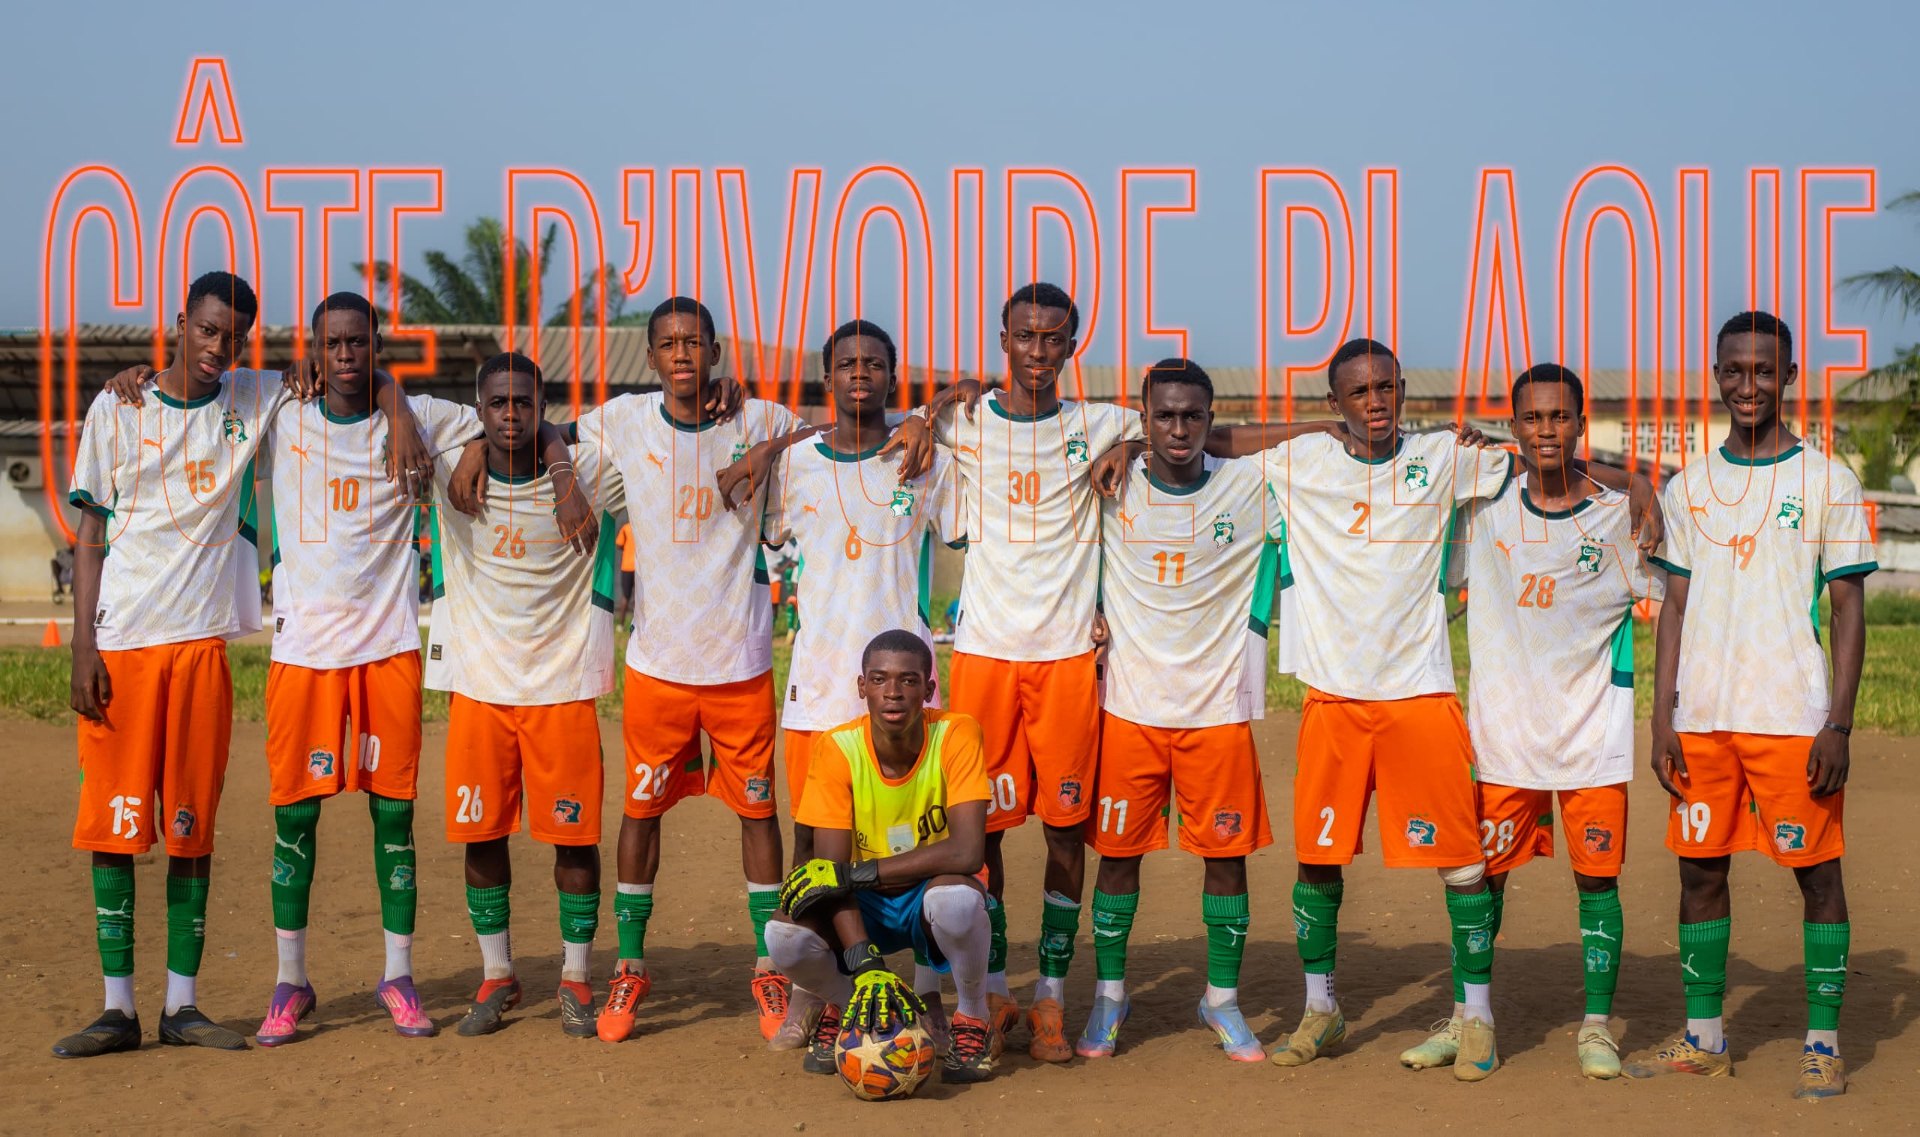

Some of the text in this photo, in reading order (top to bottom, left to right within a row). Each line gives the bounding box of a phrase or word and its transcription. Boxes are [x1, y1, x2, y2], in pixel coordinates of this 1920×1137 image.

[184, 459, 216, 495] 15
[328, 477, 360, 512] 10
[1008, 470, 1040, 505] 30
[676, 484, 714, 521] 20
[1348, 501, 1370, 535] 2
[491, 524, 526, 560] 26
[845, 525, 862, 561] 6
[1728, 533, 1757, 572] 19
[1152, 550, 1186, 585] 11
[1517, 573, 1556, 610] 28
[358, 732, 381, 773] 10
[631, 762, 671, 801] 20
[108, 795, 142, 840] 15
[455, 784, 484, 823] 26
[1099, 796, 1129, 836] 11
[1317, 806, 1335, 847] 2
[1480, 819, 1515, 857] 28
[1676, 802, 1711, 843] 19
